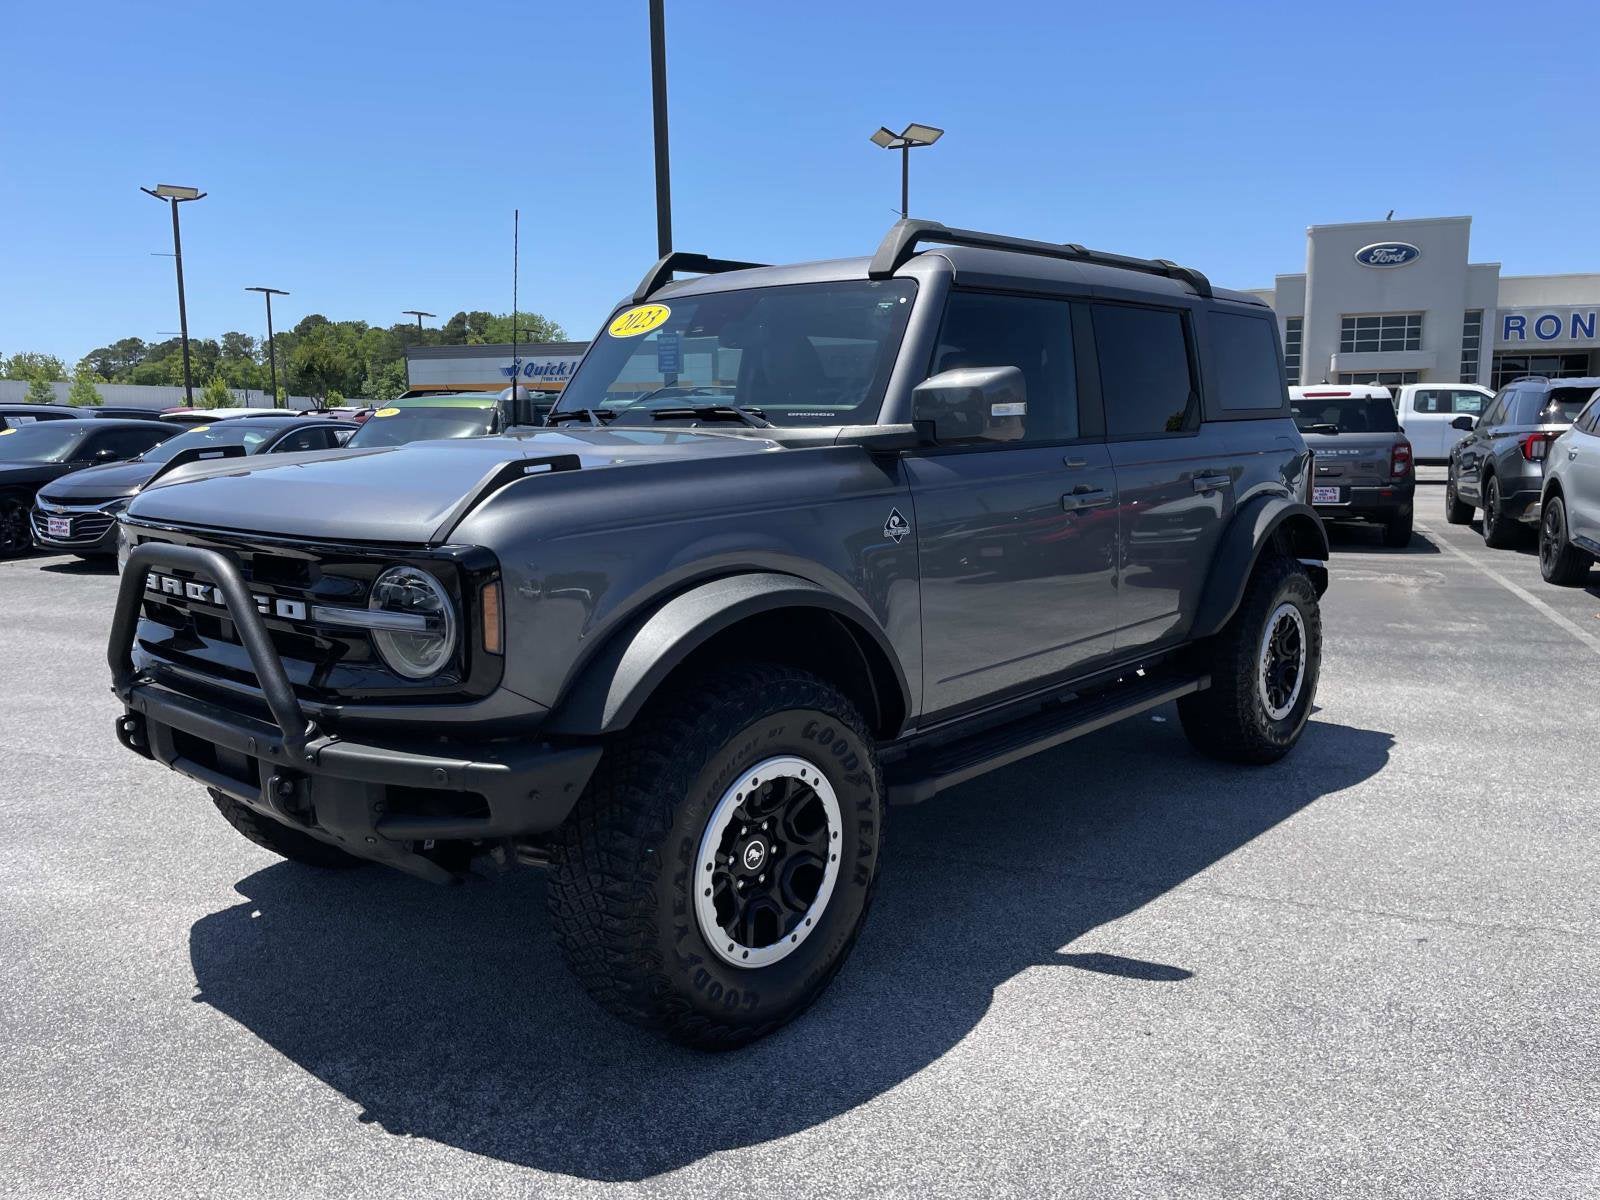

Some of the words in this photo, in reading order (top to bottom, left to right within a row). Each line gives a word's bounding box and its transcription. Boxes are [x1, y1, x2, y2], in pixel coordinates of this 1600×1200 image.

[1369, 248, 1407, 263] Ford
[614, 309, 663, 332] 2023
[1503, 312, 1597, 341] RON
[523, 361, 567, 378] Quick
